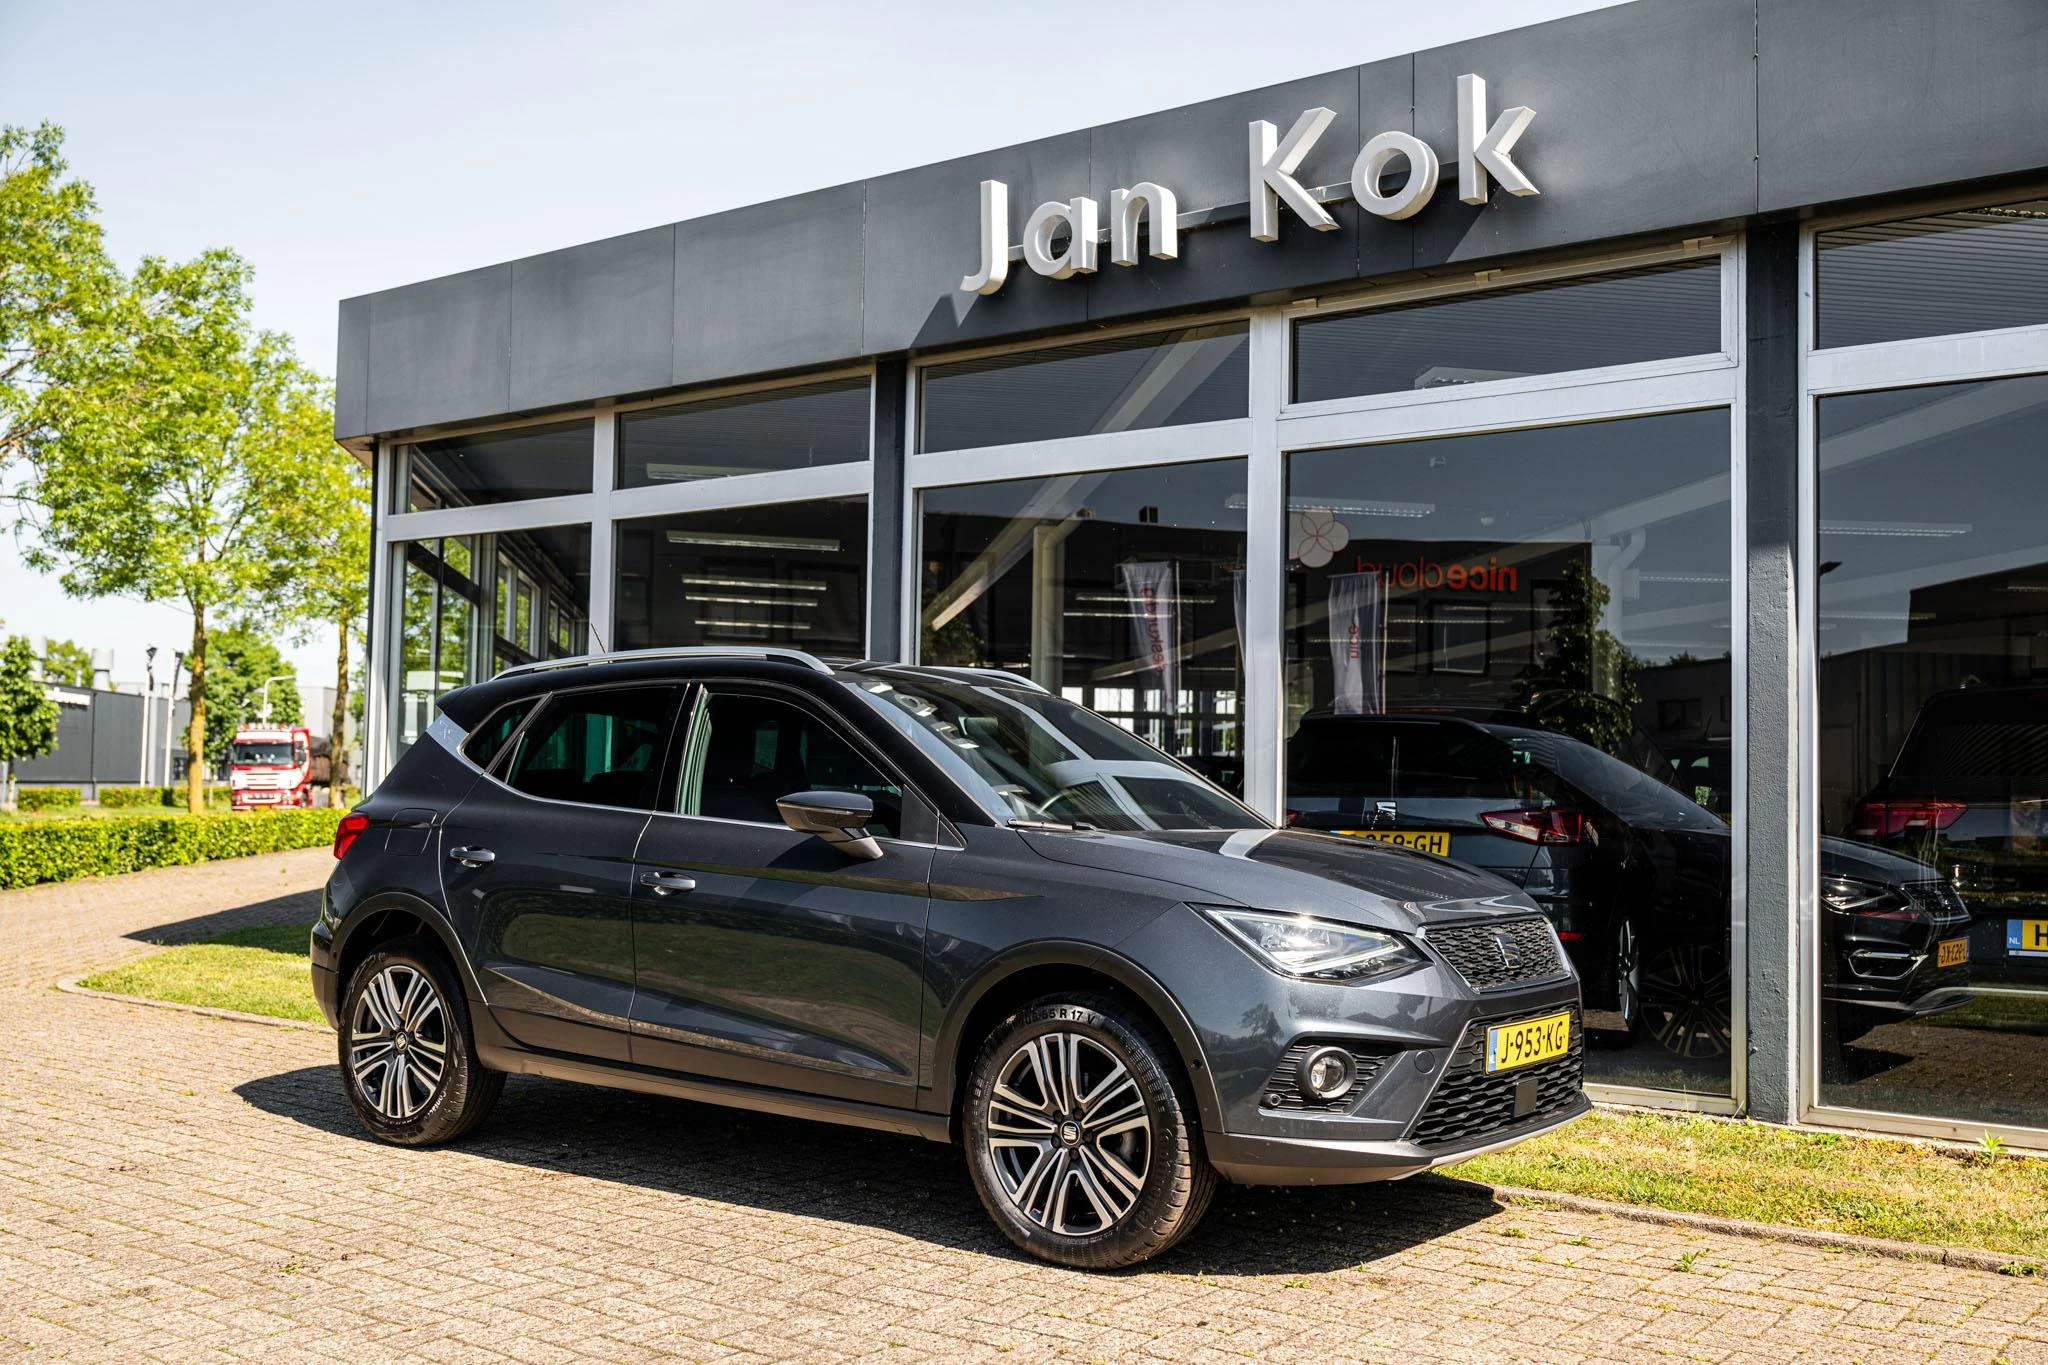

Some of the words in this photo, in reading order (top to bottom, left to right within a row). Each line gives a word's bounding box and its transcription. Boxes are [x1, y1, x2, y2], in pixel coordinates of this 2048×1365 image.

[960, 179, 1177, 295] Jan
[1249, 73, 1540, 242] Kok
[2009, 936, 2021, 945] NL
[1059, 1008, 1067, 1018] R
[1071, 1009, 1083, 1021] 17
[1501, 1021, 1563, 1064] J-953-KG
